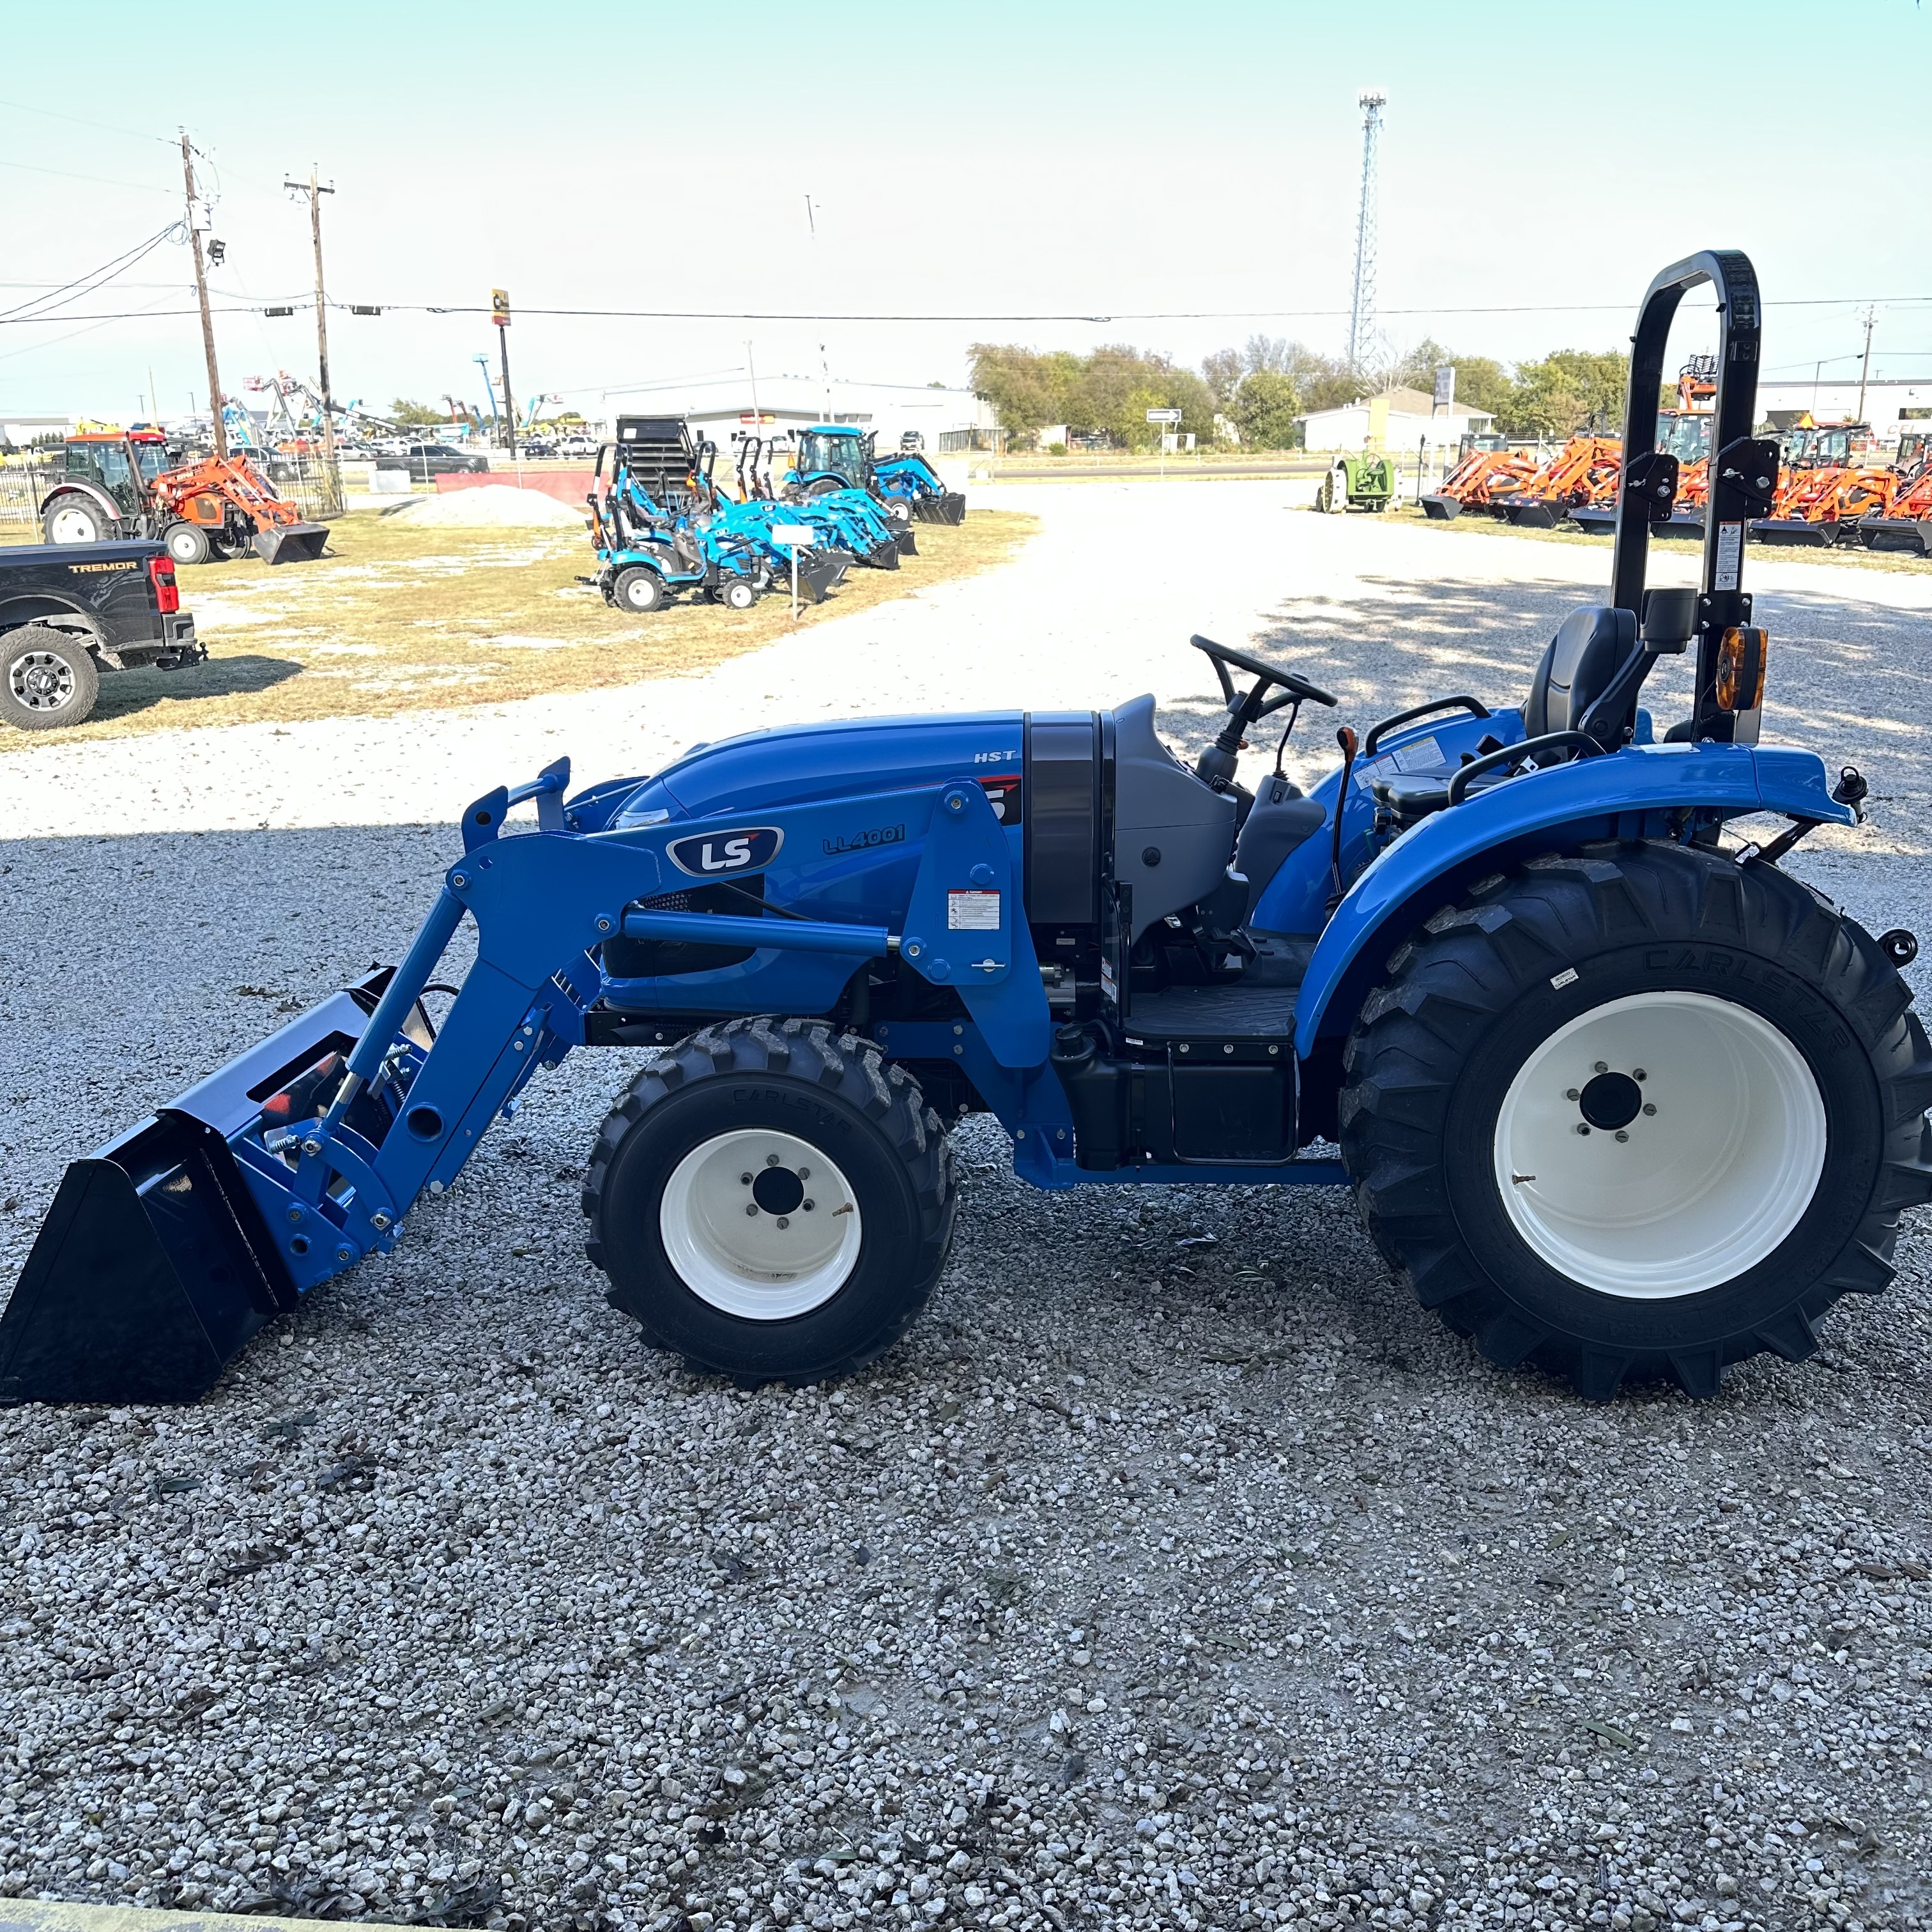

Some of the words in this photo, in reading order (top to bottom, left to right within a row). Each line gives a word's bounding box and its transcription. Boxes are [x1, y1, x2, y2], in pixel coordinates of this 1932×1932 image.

[68, 560, 139, 574] TREMOR
[974, 750, 1016, 763] HST
[702, 838, 751, 870] LS
[823, 823, 905, 855] LL4001
[1643, 947, 1851, 1056] CARLSTAR
[733, 1087, 852, 1135] CARLSTAR
